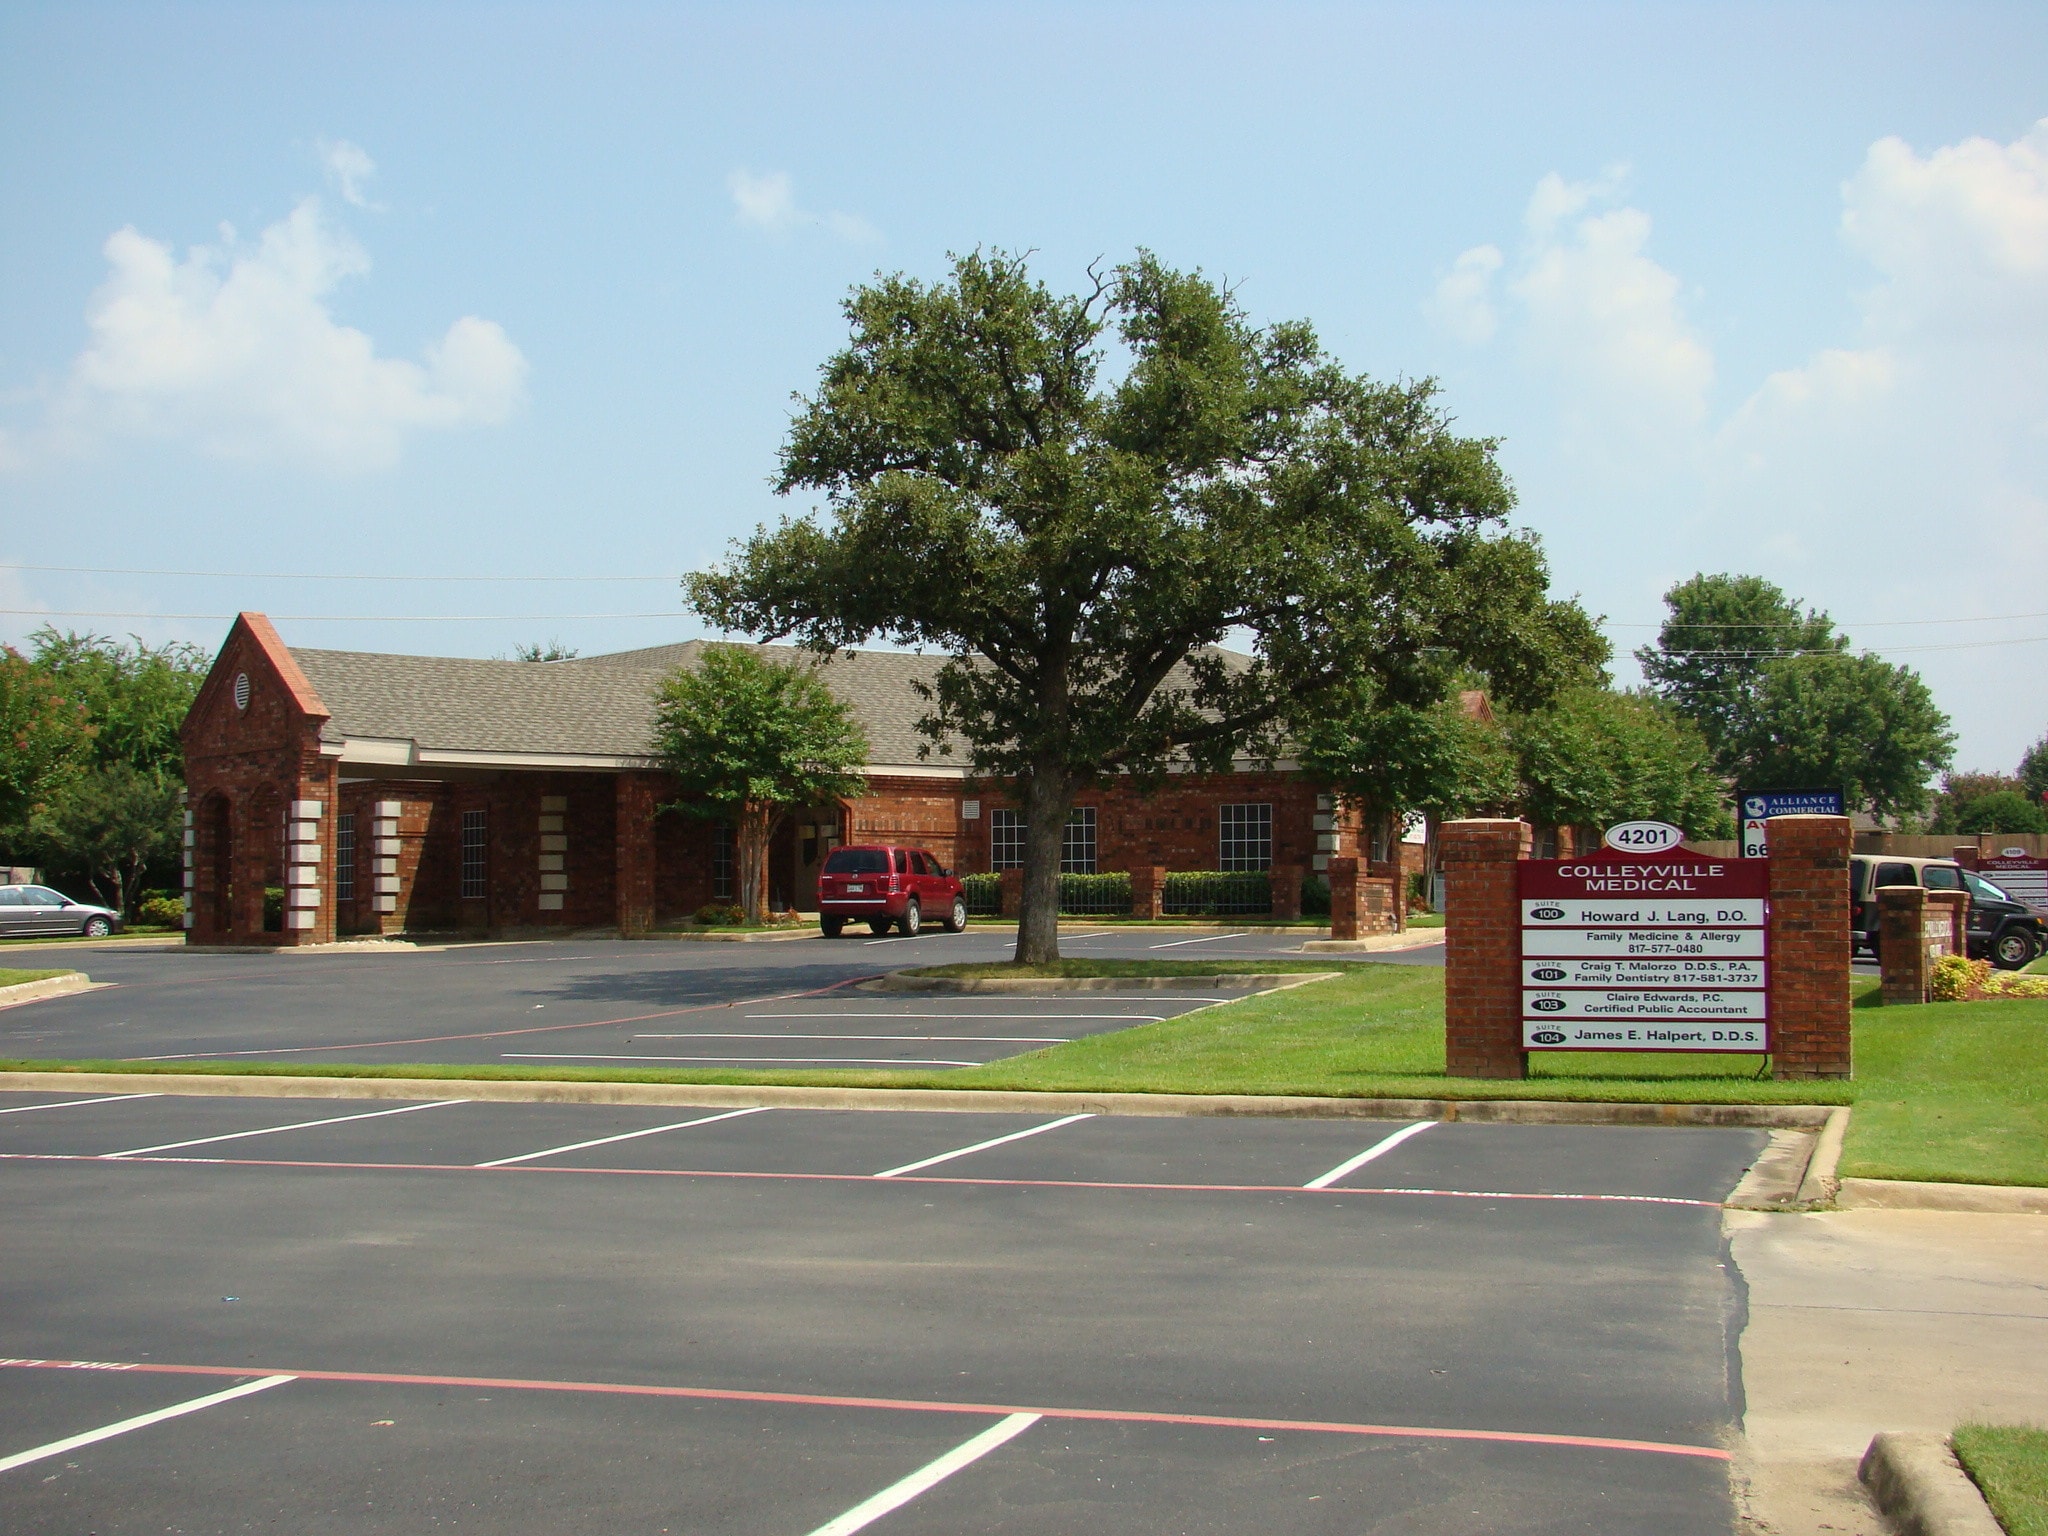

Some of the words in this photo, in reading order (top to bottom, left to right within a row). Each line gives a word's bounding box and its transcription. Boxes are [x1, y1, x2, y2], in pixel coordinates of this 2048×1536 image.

[1771, 796, 1836, 806] ALLIANCE
[1768, 805, 1839, 815] COMMERCIAL
[1618, 829, 1668, 845] 4201
[1557, 865, 1724, 877] COLLEYVILLE
[1586, 879, 1697, 891] MEDICAL
[1539, 909, 1559, 919] 100
[1581, 910, 1640, 922] Howard
[1647, 910, 1660, 922] J.
[1667, 910, 1709, 924] Lang,
[1717, 910, 1747, 922] D.O.
[1586, 932, 1622, 943] Family
[1628, 932, 1679, 941] Medicine
[1684, 932, 1693, 941] &
[1700, 932, 1741, 943] Allergy
[1581, 962, 1611, 972] Craig
[1615, 962, 1625, 971] T.
[1629, 962, 1677, 971] Malorzo
[1728, 962, 1751, 971] P.A.
[1539, 970, 1559, 979] 101
[1574, 973, 1612, 984] Family
[1616, 973, 1670, 984] Dentistry
[1673, 974, 1758, 983] 817-581-3737
[1606, 993, 1640, 1002] Claire
[1643, 993, 1698, 1003] Edwards,
[1702, 993, 1724, 1002] P.C.
[1539, 1001, 1559, 1010] 103
[1584, 1004, 1634, 1013] Certified
[1638, 1004, 1674, 1013] Public
[1677, 1005, 1748, 1014] Accountant
[1539, 1033, 1560, 1042] 104
[1574, 1029, 1623, 1040] James
[1628, 1030, 1641, 1040] E.
[1646, 1030, 1706, 1043] Halpert,
[1712, 1031, 1759, 1042] D.D.S.
